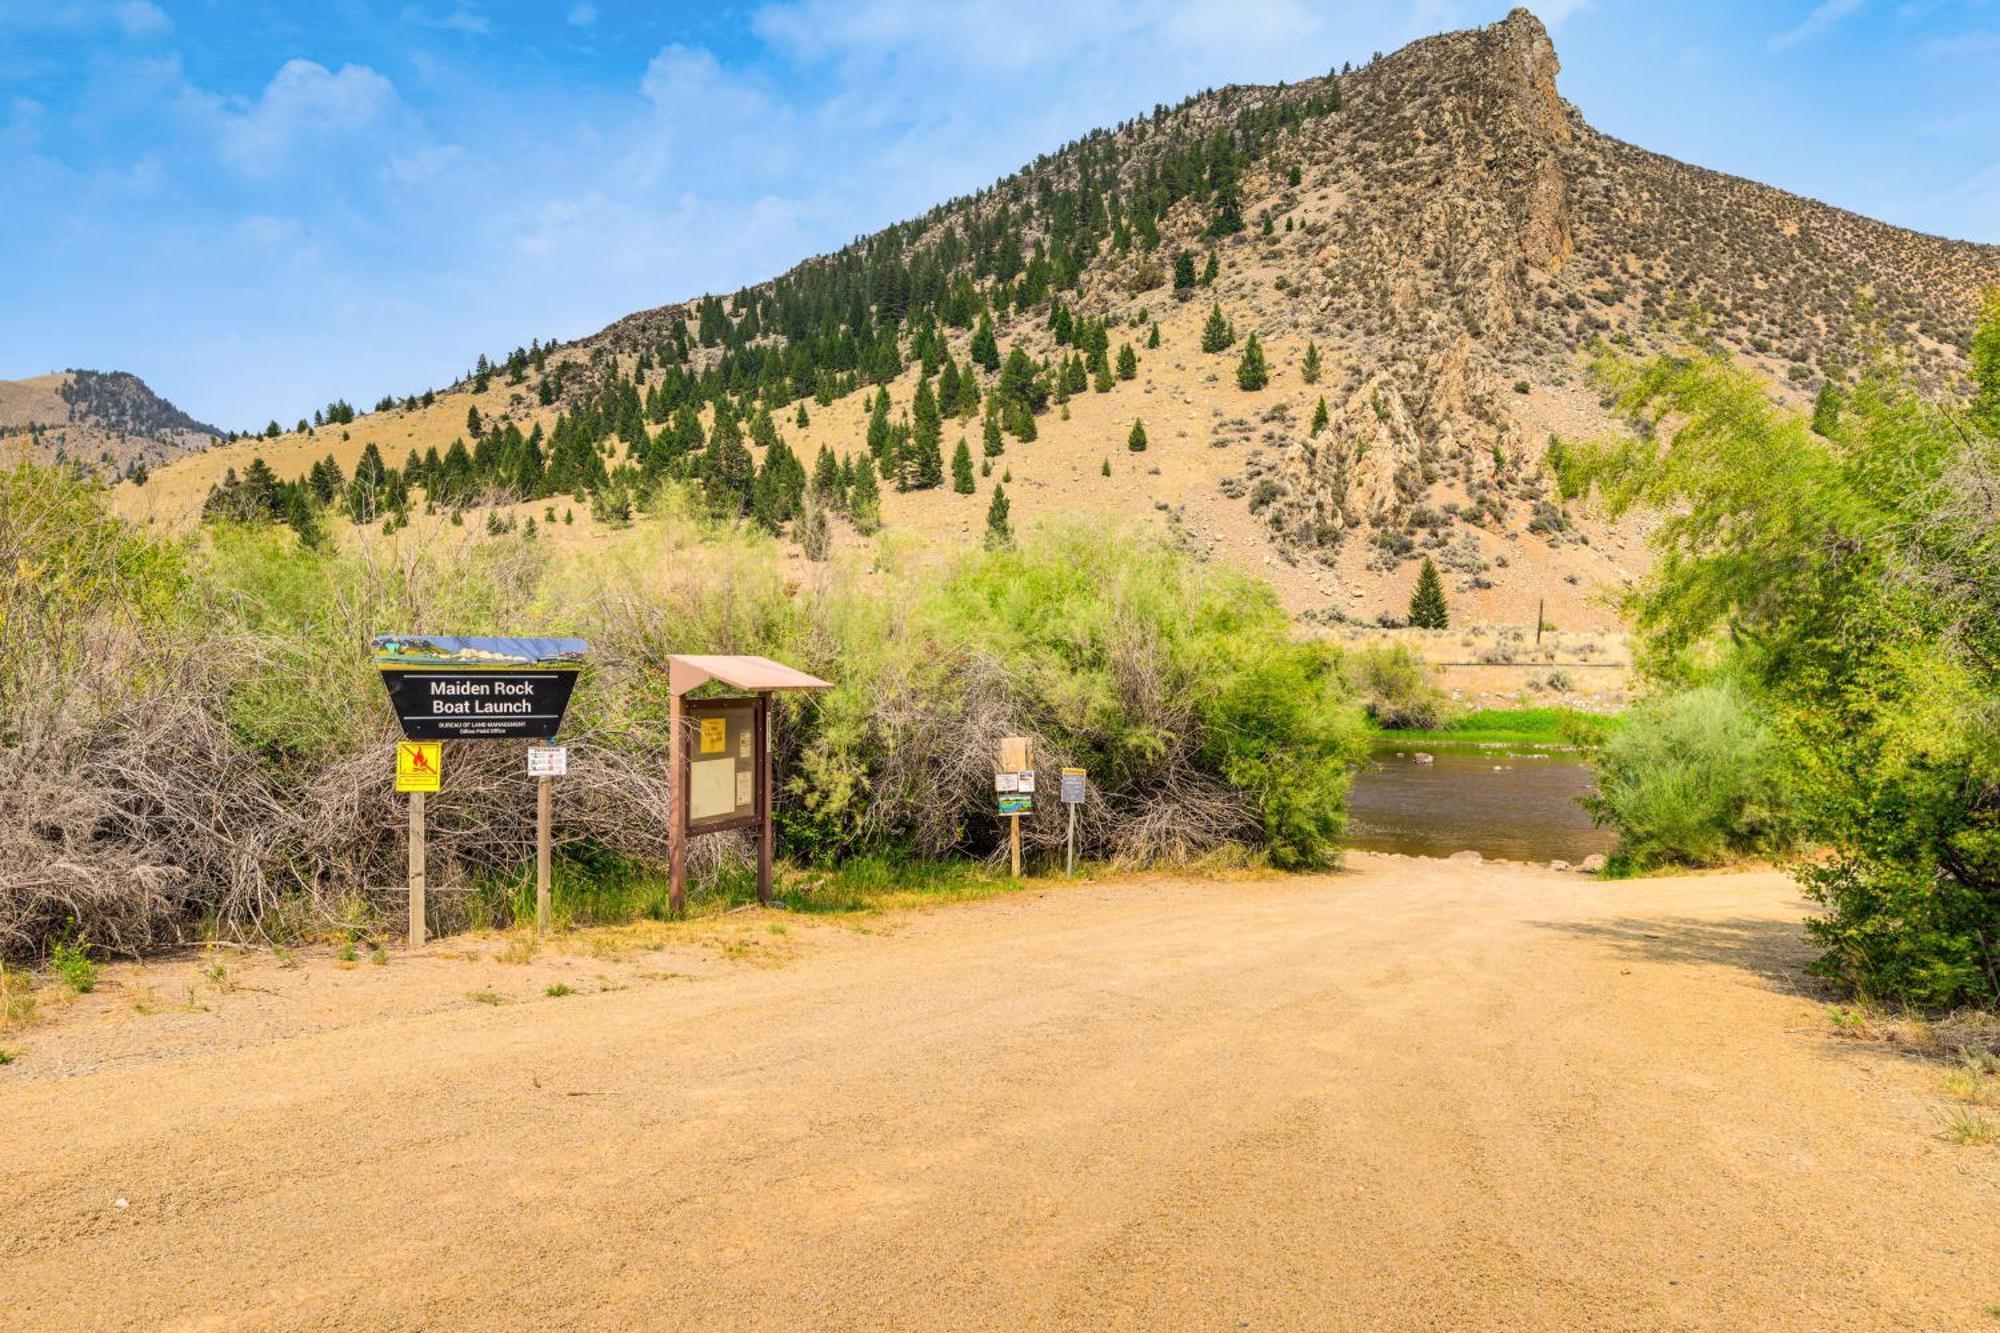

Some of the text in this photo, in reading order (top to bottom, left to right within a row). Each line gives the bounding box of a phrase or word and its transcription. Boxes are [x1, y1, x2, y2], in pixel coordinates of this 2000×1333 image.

[430, 681, 534, 695] Maiden Rock
[432, 699, 532, 714] Boat Launch
